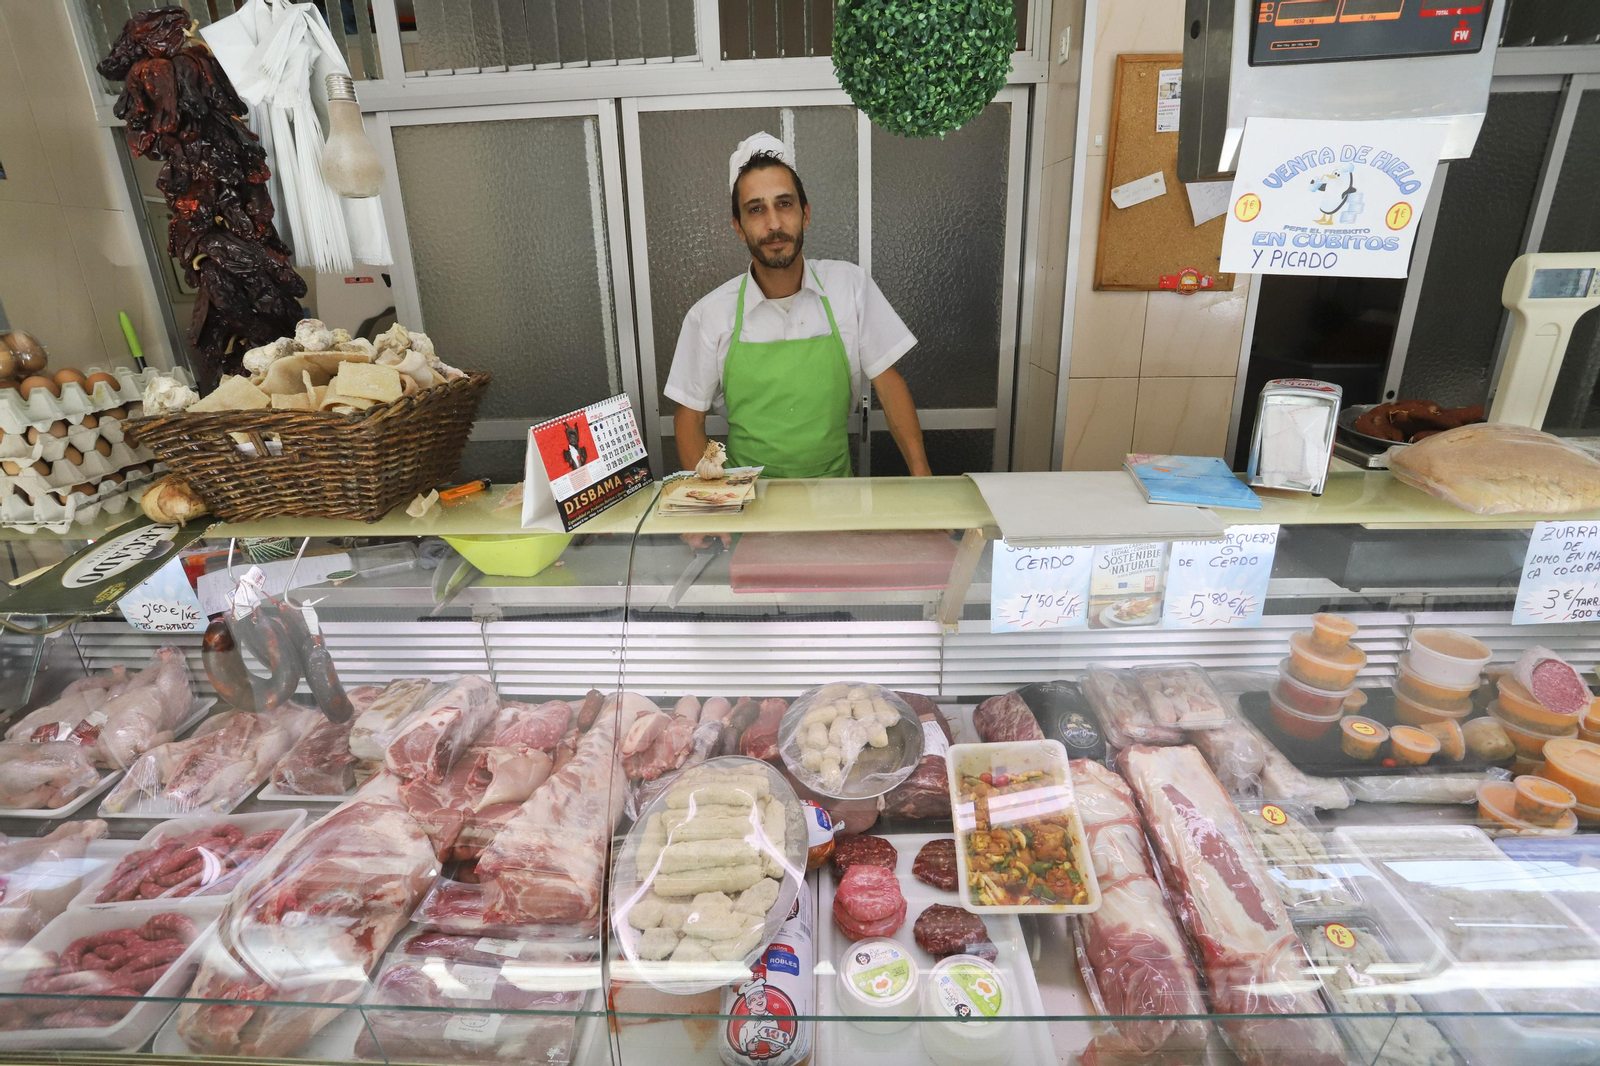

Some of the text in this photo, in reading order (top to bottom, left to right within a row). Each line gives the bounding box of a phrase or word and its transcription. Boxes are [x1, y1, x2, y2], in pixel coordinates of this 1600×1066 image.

[1453, 30, 1469, 41] FW
[1262, 144, 1422, 195] VENTA DE HIELO
[1282, 224, 1371, 235] PEPE EL FRESKITO
[1251, 231, 1400, 251] EN CUBITOS
[1251, 249, 1339, 270] Y PICADO
[599, 444, 605, 452] 13
[616, 436, 621, 444] 16
[602, 454, 609, 462] 20
[608, 451, 614, 459] 21
[613, 448, 619, 456] 22
[625, 443, 631, 451] 24
[630, 440, 636, 448] 25
[635, 438, 641, 446] 26
[611, 461, 617, 469] 28
[628, 452, 634, 460] 31
[563, 475, 623, 515] DISBAMA
[76, 524, 177, 584] LEGADO
[1563, 541, 1583, 552] DE
[1015, 555, 1075, 571] CERDO
[1098, 549, 1162, 570] SOSTENIBLE
[1178, 556, 1259, 568] DE CERDO
[1529, 554, 1560, 566] LOMO
[1565, 551, 1586, 563] EN
[1111, 559, 1156, 575] NATURAL
[1526, 567, 1541, 580] CA
[1570, 608, 1593, 620] 500
[155, 622, 195, 631] CORTADO
